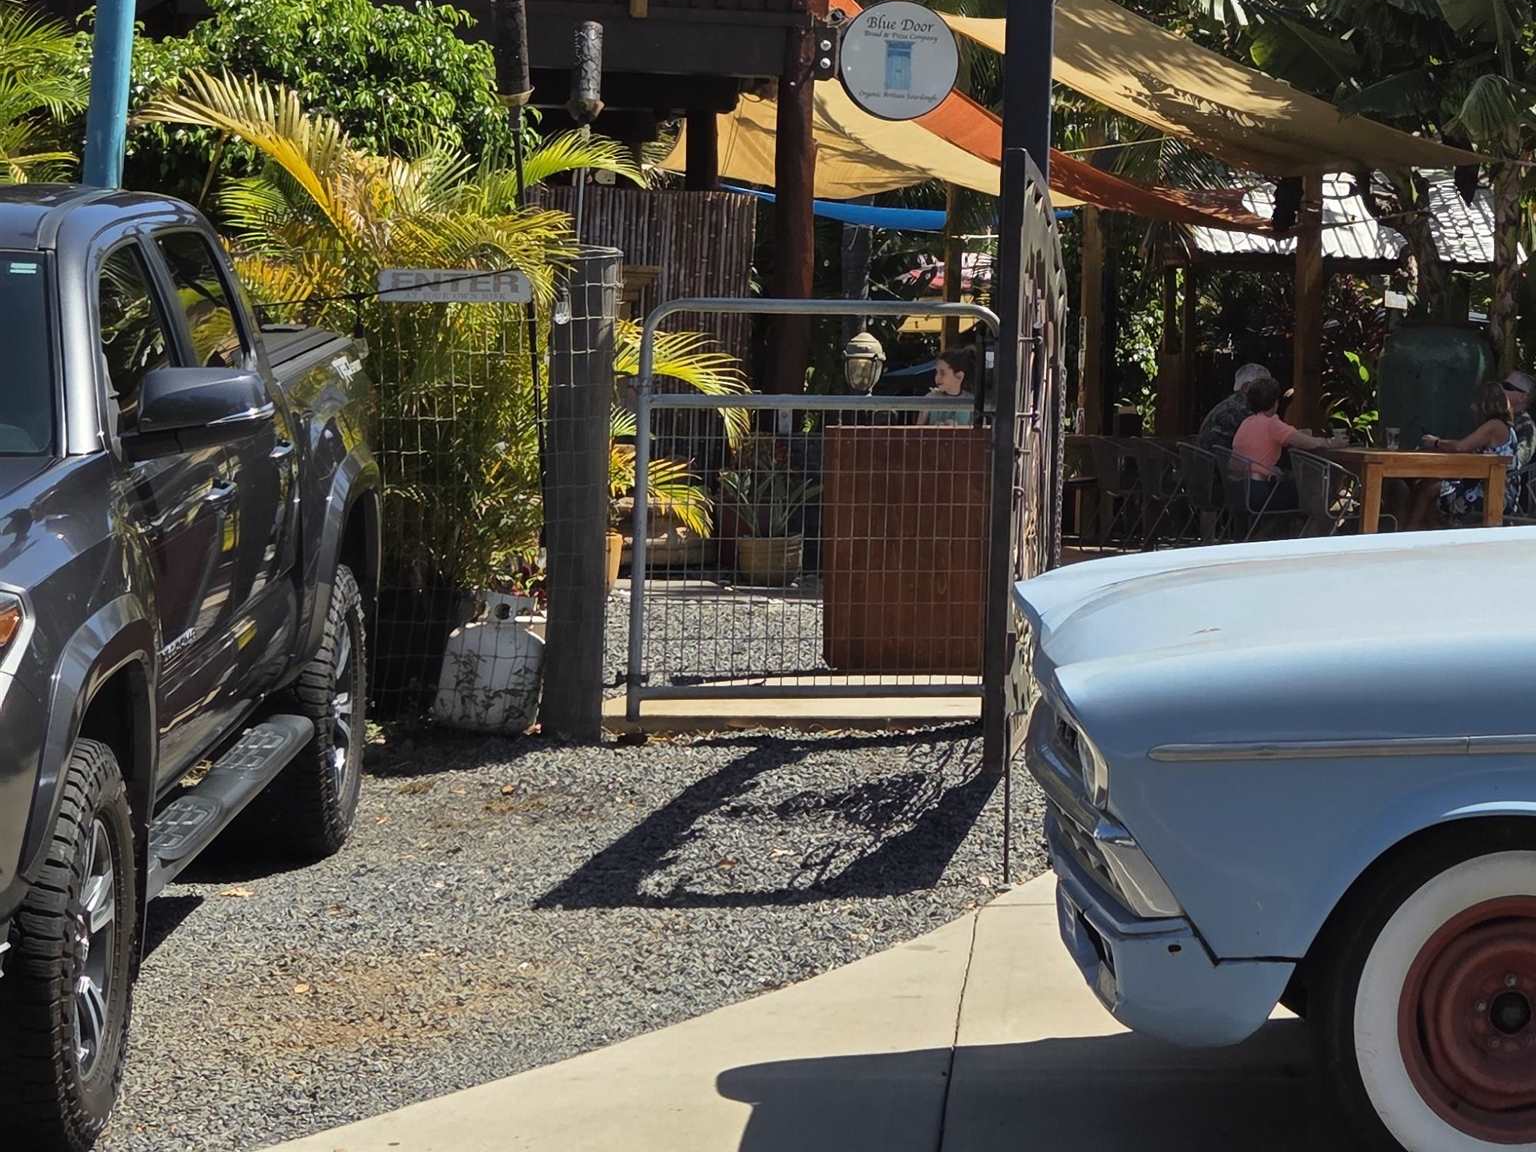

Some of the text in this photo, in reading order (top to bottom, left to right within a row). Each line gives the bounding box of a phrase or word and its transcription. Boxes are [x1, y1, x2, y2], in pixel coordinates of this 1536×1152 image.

[867, 14, 935, 33] Blue Door
[391, 272, 520, 294] ENTER
